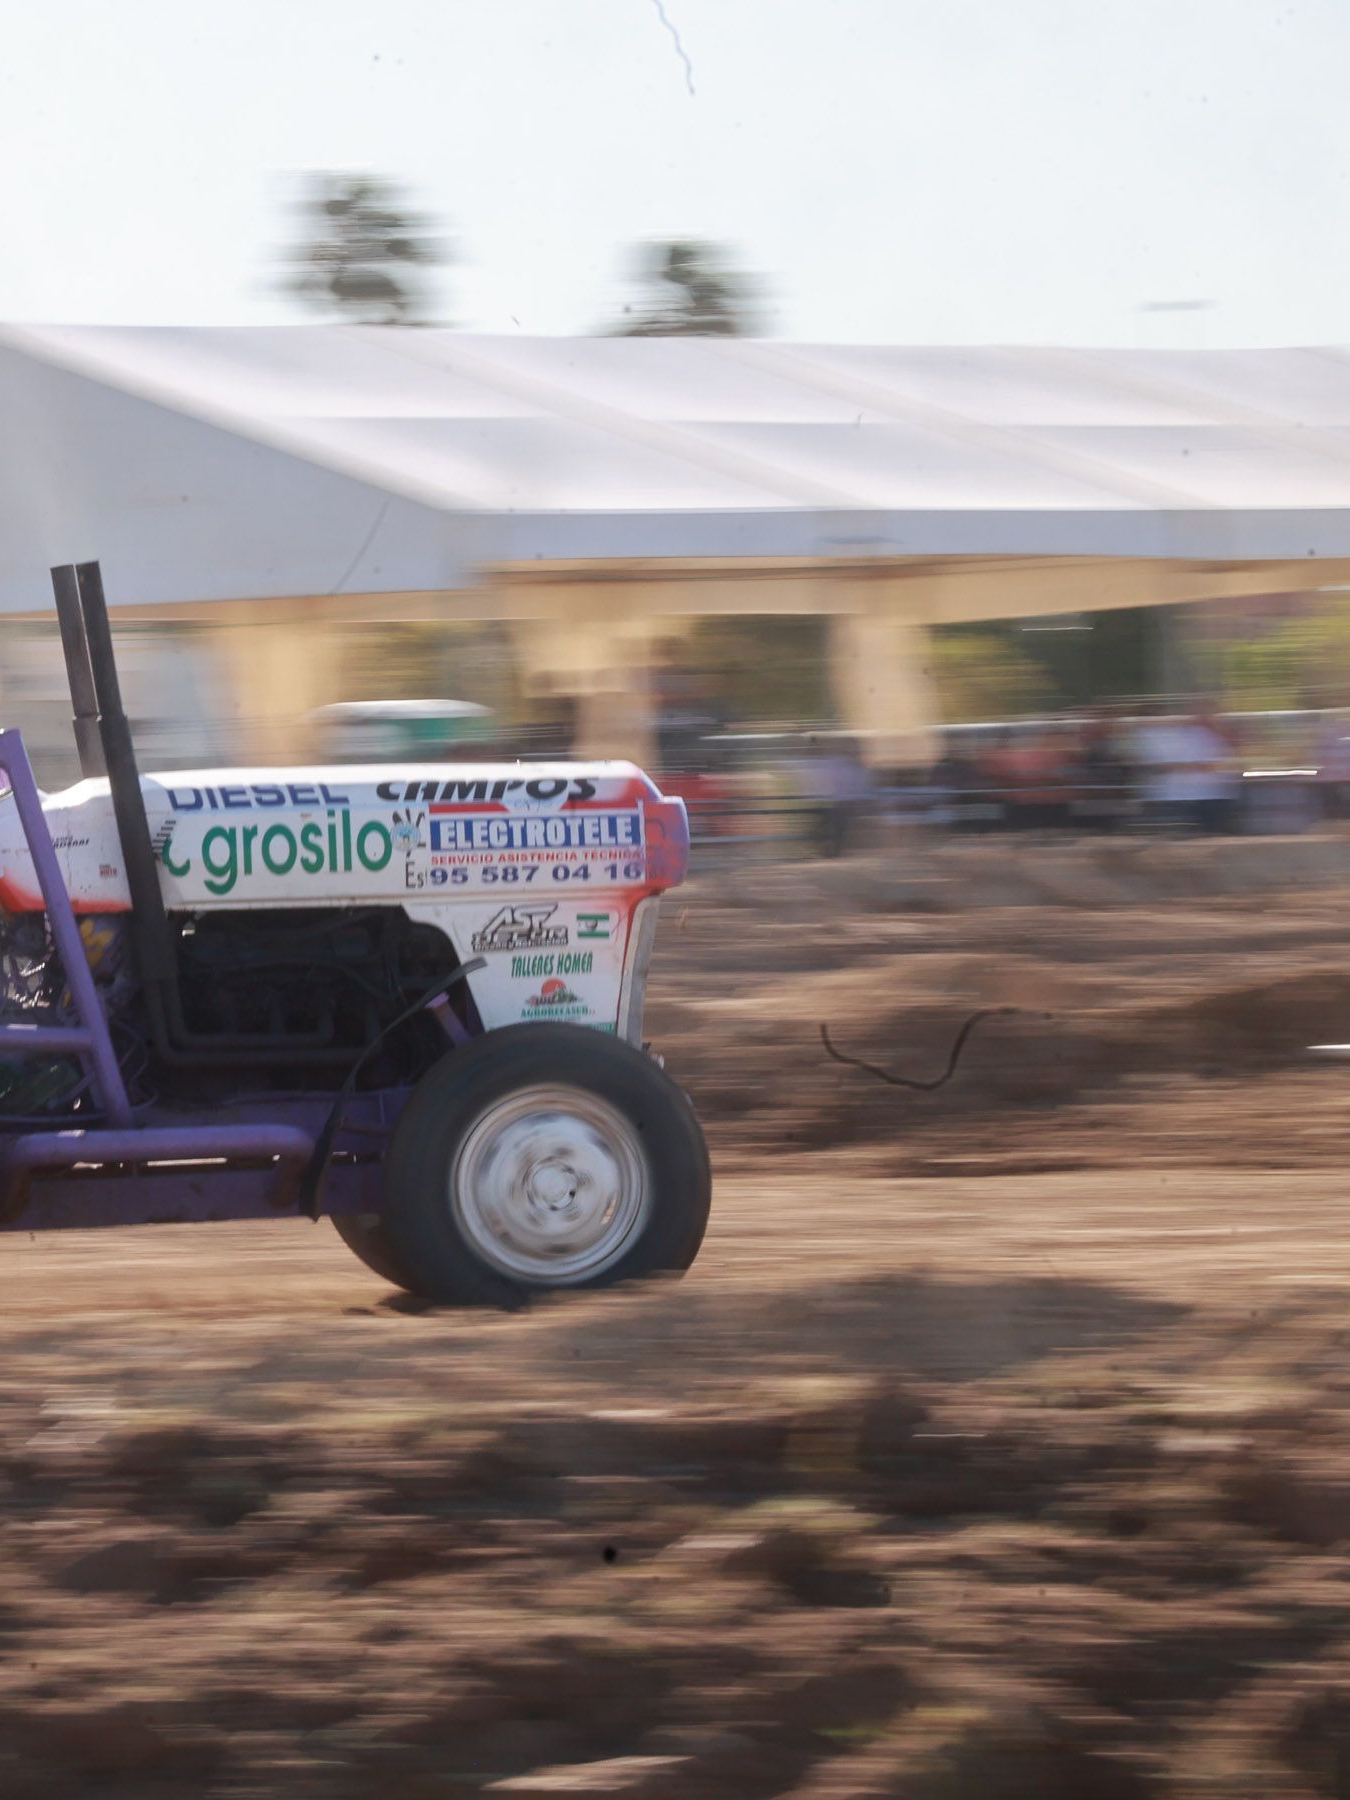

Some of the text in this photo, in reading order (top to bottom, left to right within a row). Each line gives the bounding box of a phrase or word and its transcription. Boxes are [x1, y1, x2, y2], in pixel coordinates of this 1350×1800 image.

[167, 782, 350, 810] DIESEL
[439, 815, 633, 849] ELECTROTELE
[431, 855, 493, 865] SERVICIO
[498, 853, 578, 863] ASISTENCIA
[430, 862, 642, 886] 95 587 04 16
[511, 954, 554, 978] TALLERES
